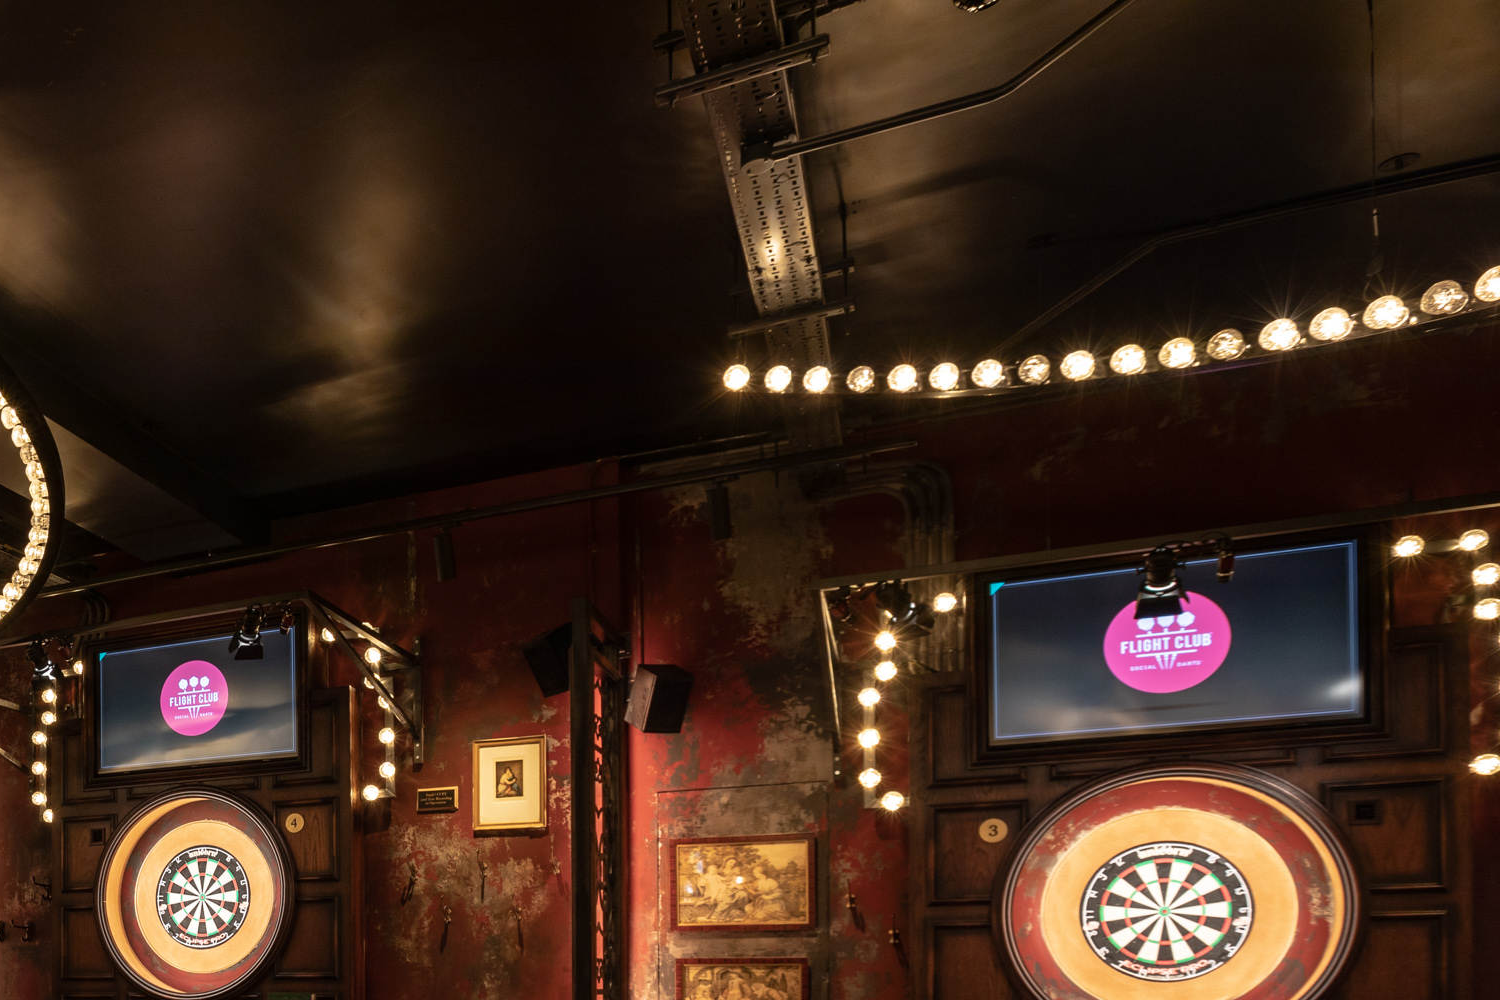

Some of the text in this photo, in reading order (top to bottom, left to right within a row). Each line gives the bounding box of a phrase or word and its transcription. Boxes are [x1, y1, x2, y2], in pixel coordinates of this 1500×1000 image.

[1120, 633, 1212, 654] FLIGHT CLUB
[169, 692, 219, 707] FLIGHT CLUB
[290, 817, 298, 828] 4
[988, 824, 998, 837] 3
[179, 933, 209, 944] ECLIPSE
[1122, 959, 1209, 975] ECLIPSE PRO
